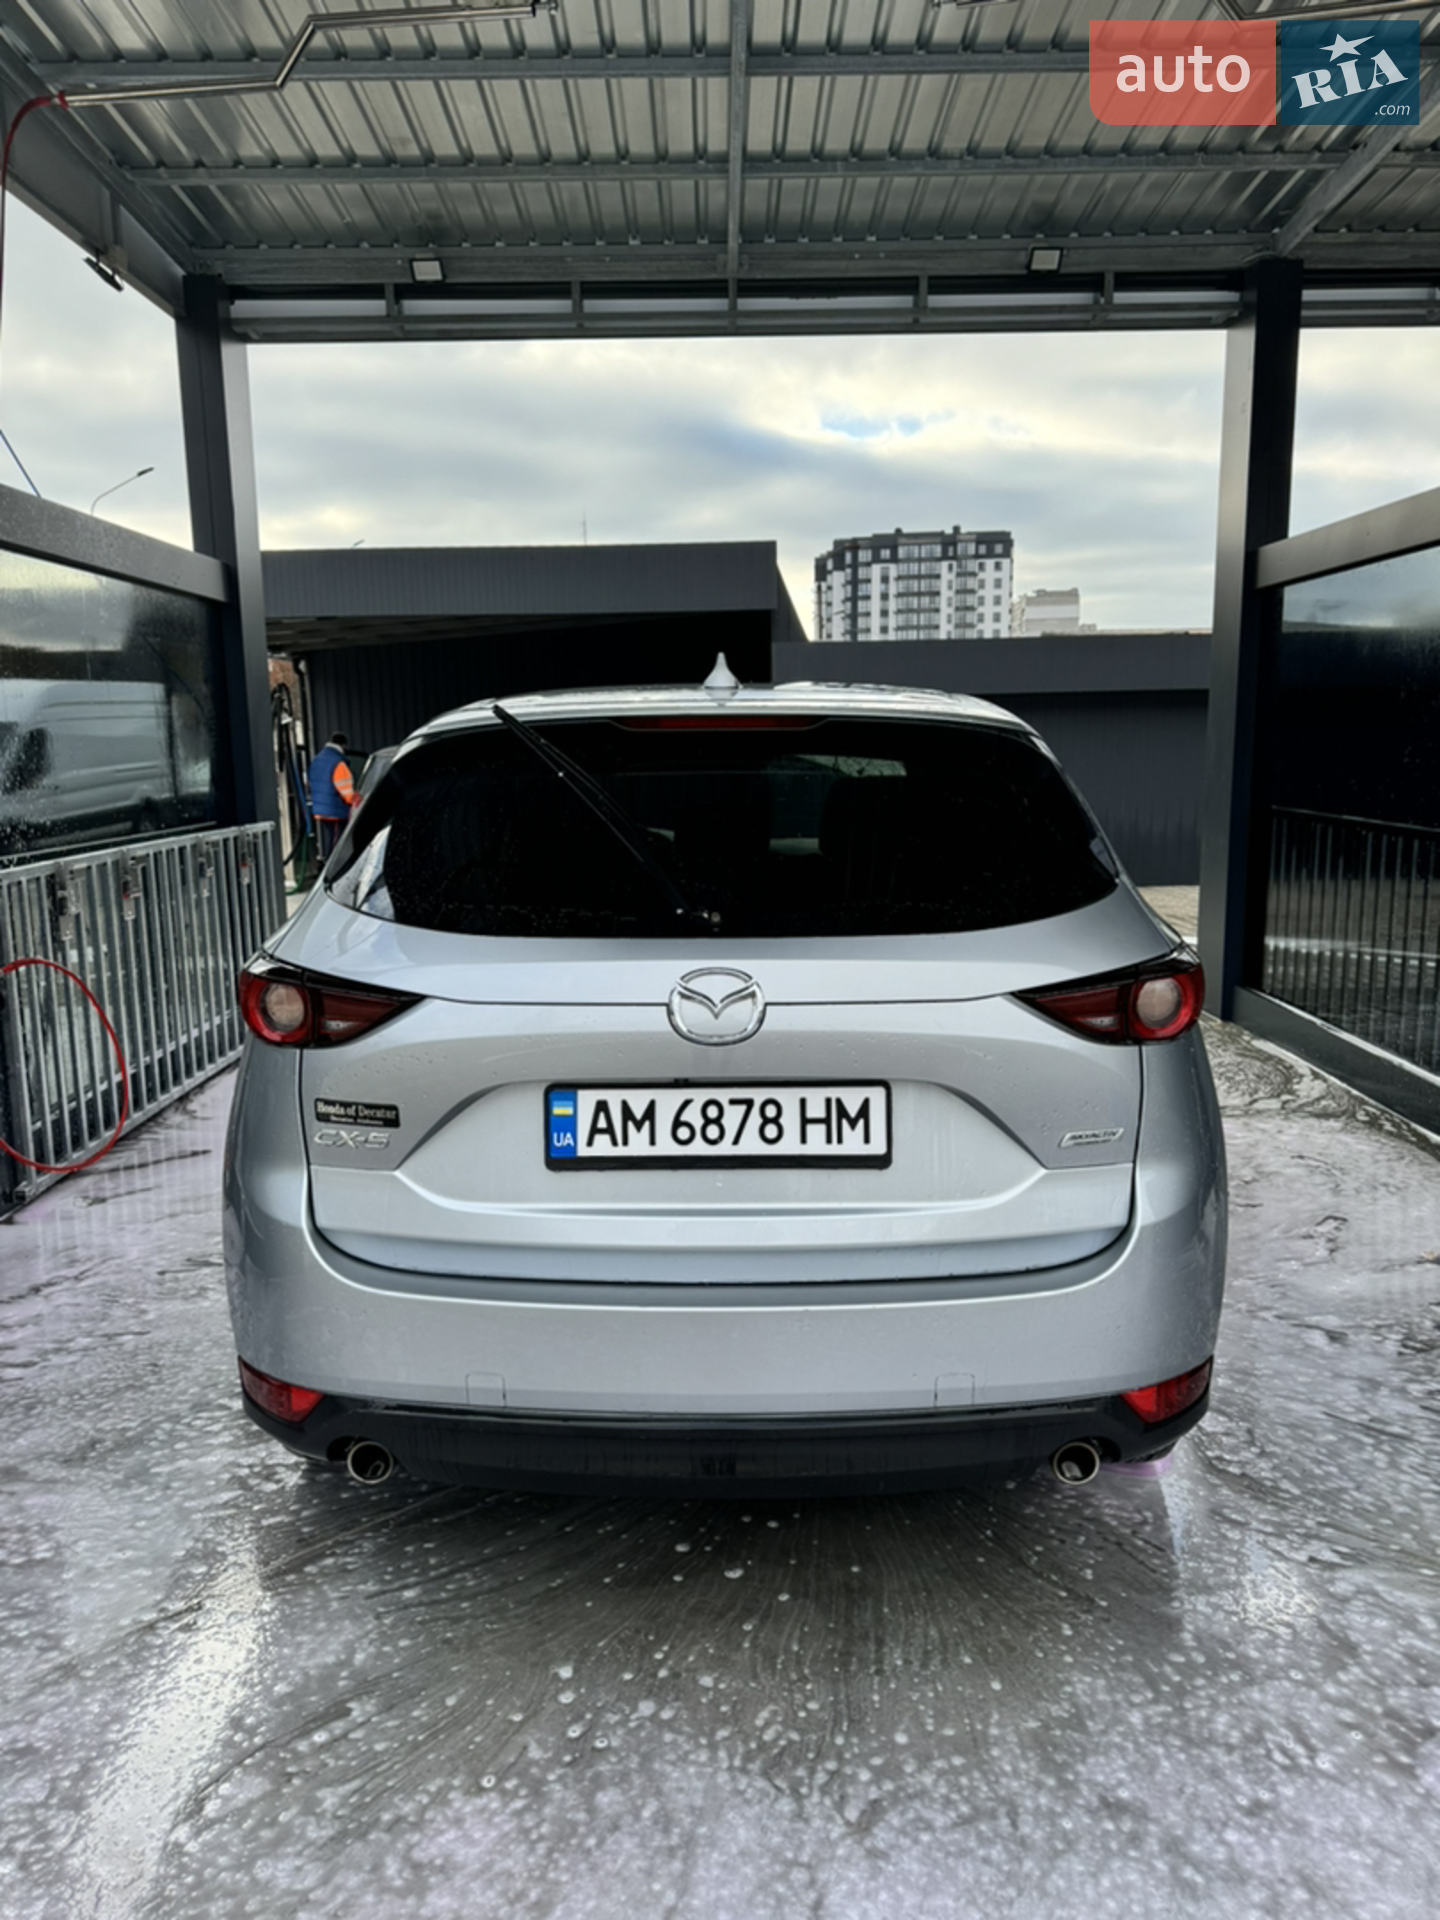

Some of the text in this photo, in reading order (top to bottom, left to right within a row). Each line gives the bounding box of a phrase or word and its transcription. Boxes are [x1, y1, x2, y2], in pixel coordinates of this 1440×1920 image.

[586, 1097, 870, 1147] AM 6878 HM
[314, 1129, 389, 1149] CX-5
[553, 1132, 575, 1147] UA
